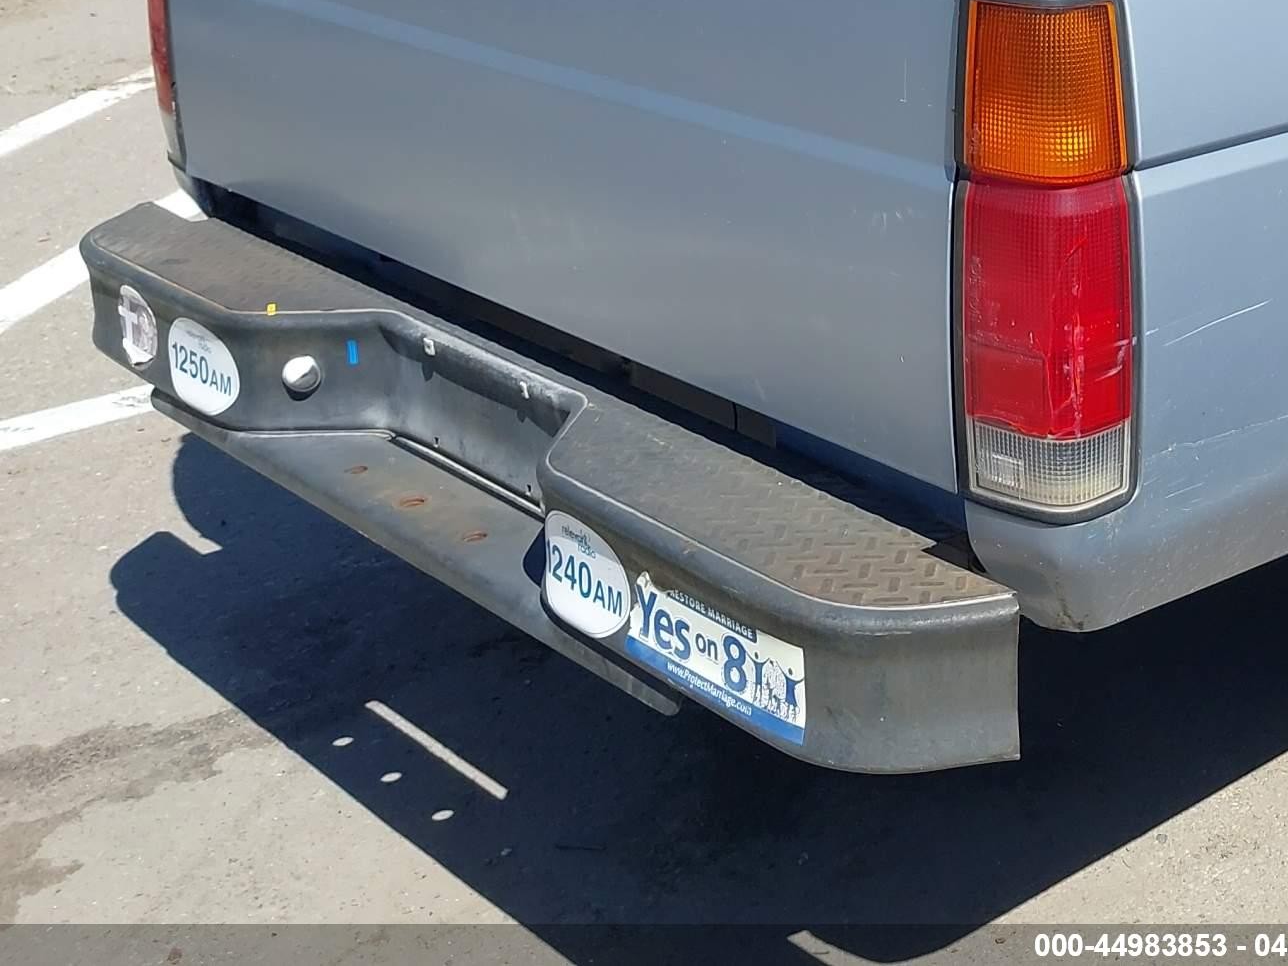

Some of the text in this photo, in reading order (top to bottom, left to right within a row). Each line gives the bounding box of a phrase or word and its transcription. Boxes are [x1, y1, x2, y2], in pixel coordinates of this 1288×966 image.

[636, 585, 748, 693] Yes on 8
[707, 607, 754, 639] MARRIAGE
[667, 661, 753, 716] www.ProtectMarriage.com
